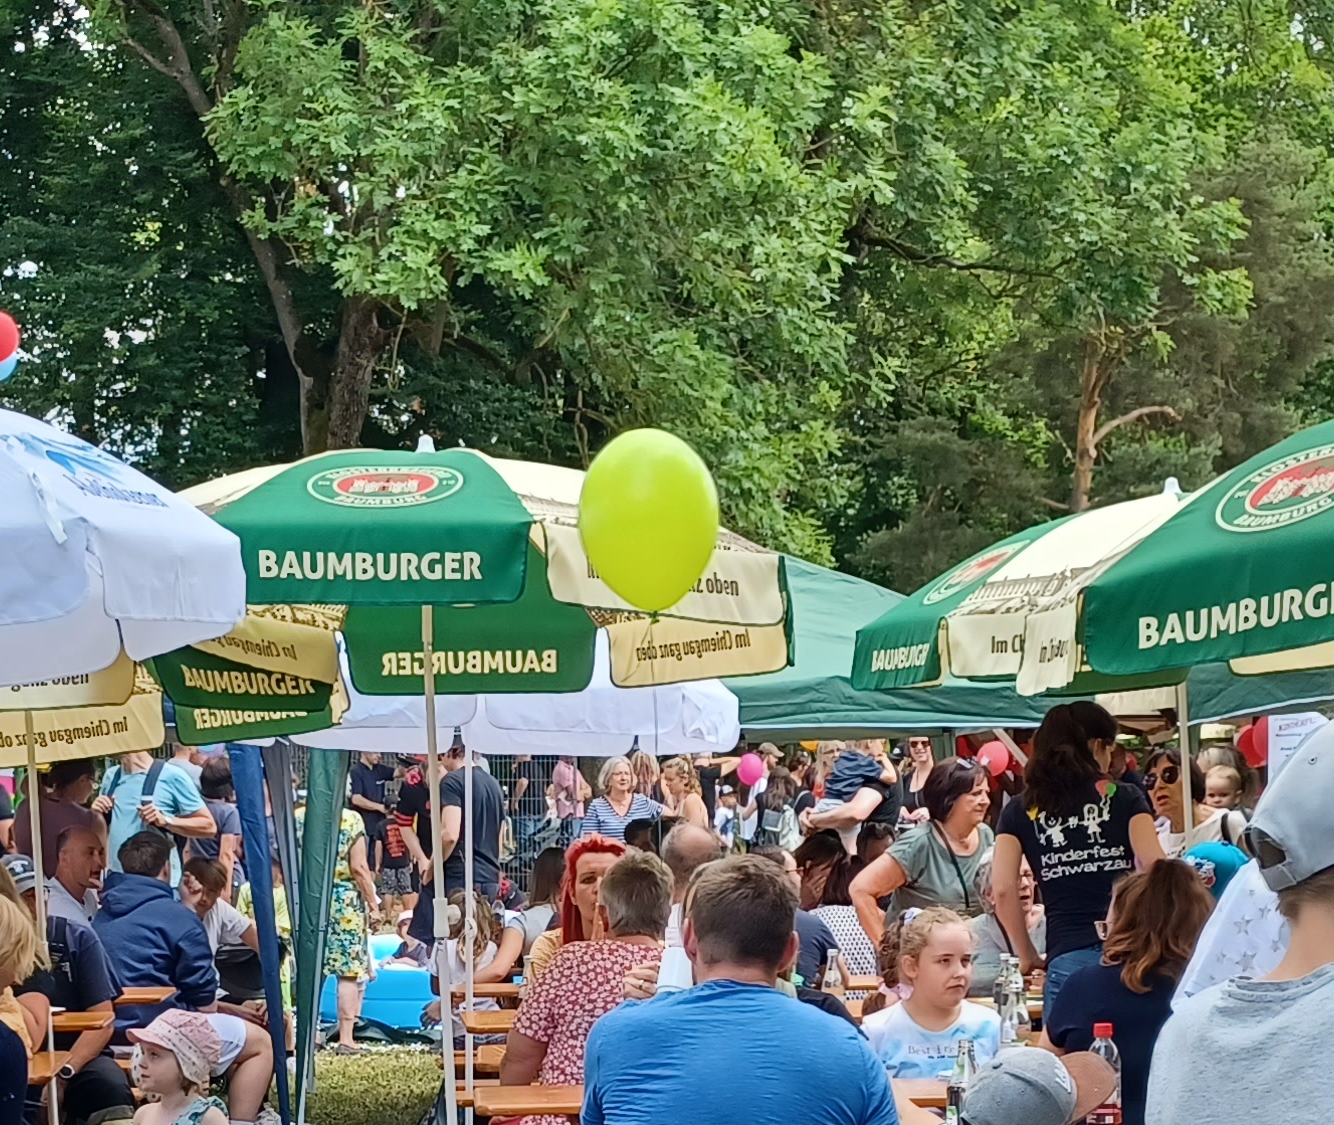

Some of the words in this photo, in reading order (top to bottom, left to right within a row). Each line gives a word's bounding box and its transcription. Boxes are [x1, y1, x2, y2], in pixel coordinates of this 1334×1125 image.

[258, 549, 483, 581] BAUMBURGER
[991, 636, 1008, 654] Im
[1041, 845, 1125, 867] Kinderfest
[1041, 859, 1132, 881] Schwarzau
